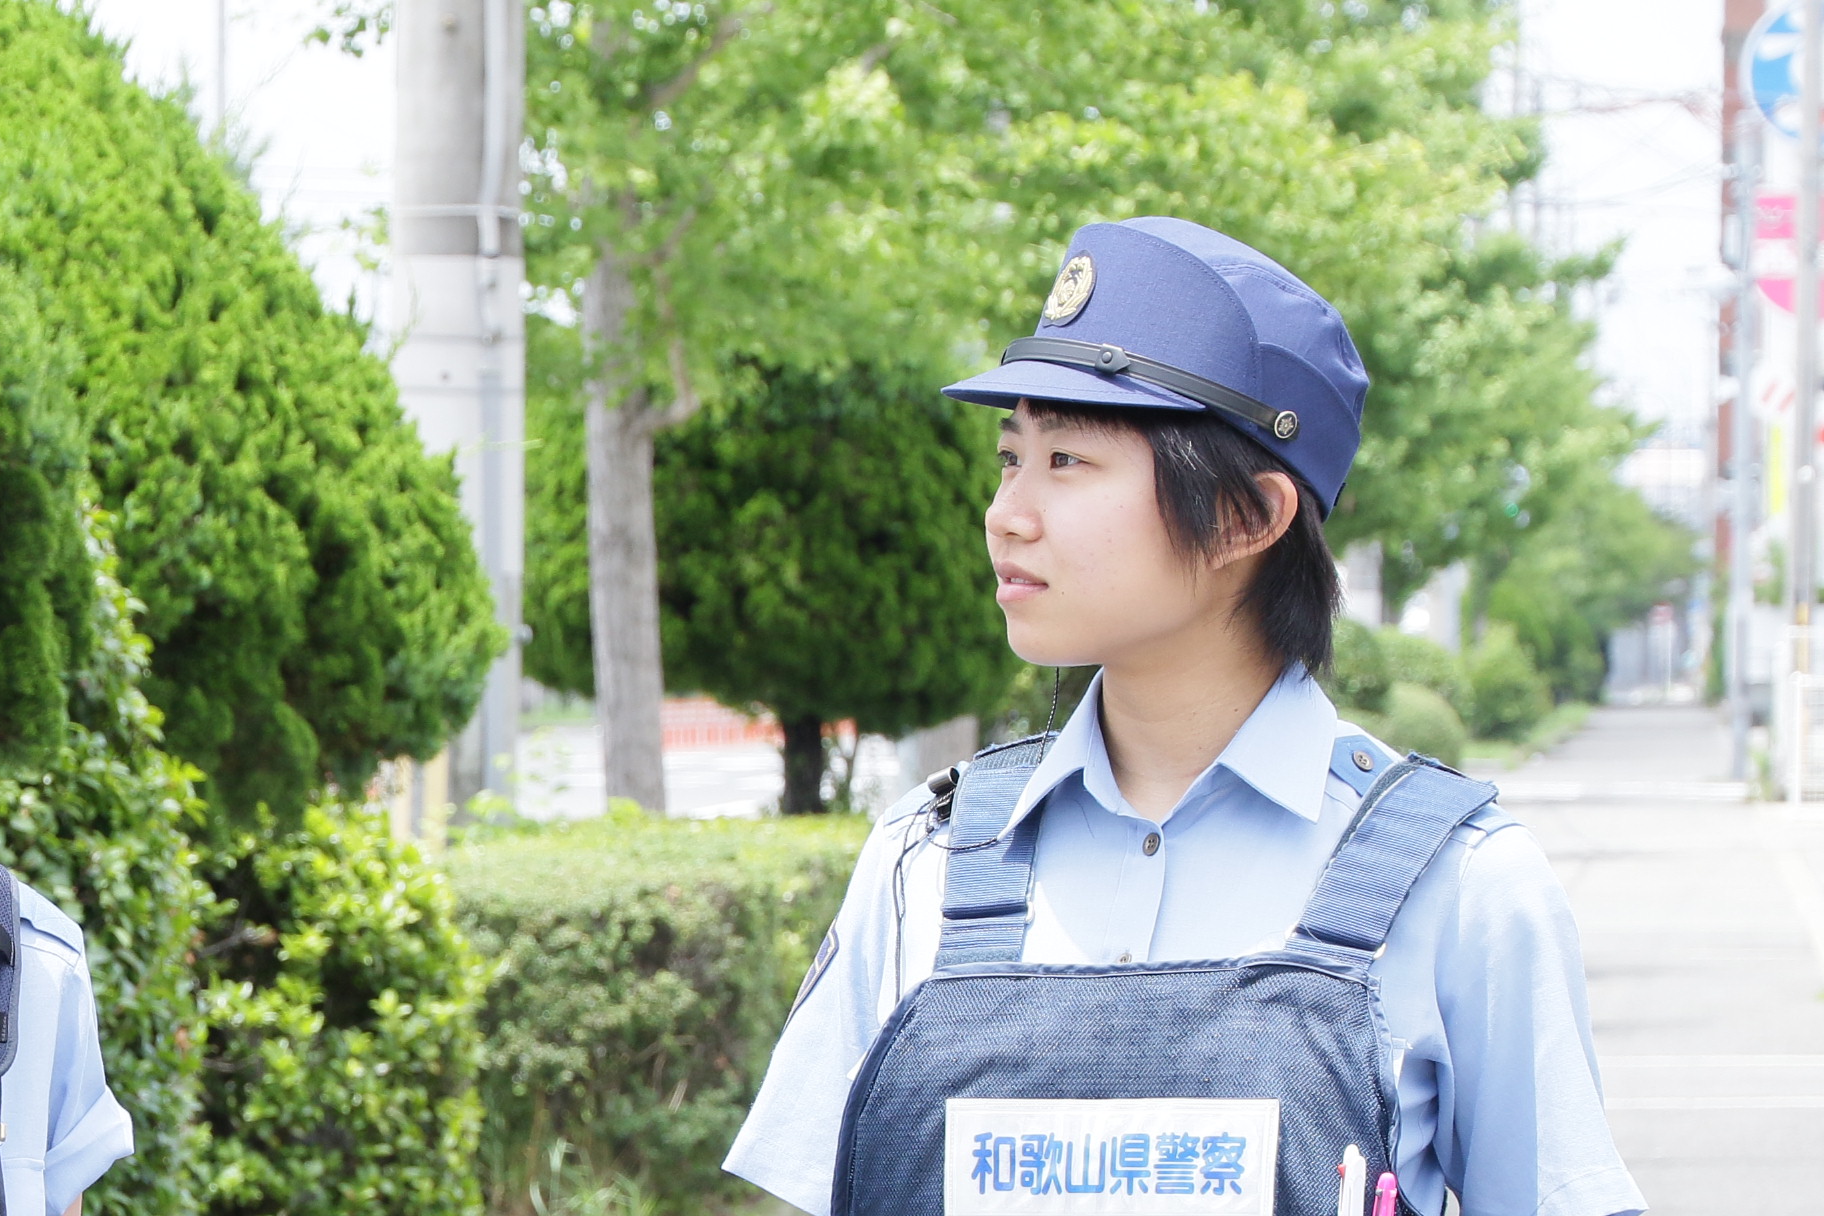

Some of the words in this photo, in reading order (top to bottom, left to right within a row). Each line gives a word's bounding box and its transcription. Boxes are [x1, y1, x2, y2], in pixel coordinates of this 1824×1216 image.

[971, 1132, 1247, 1196] 和歌山県警察
